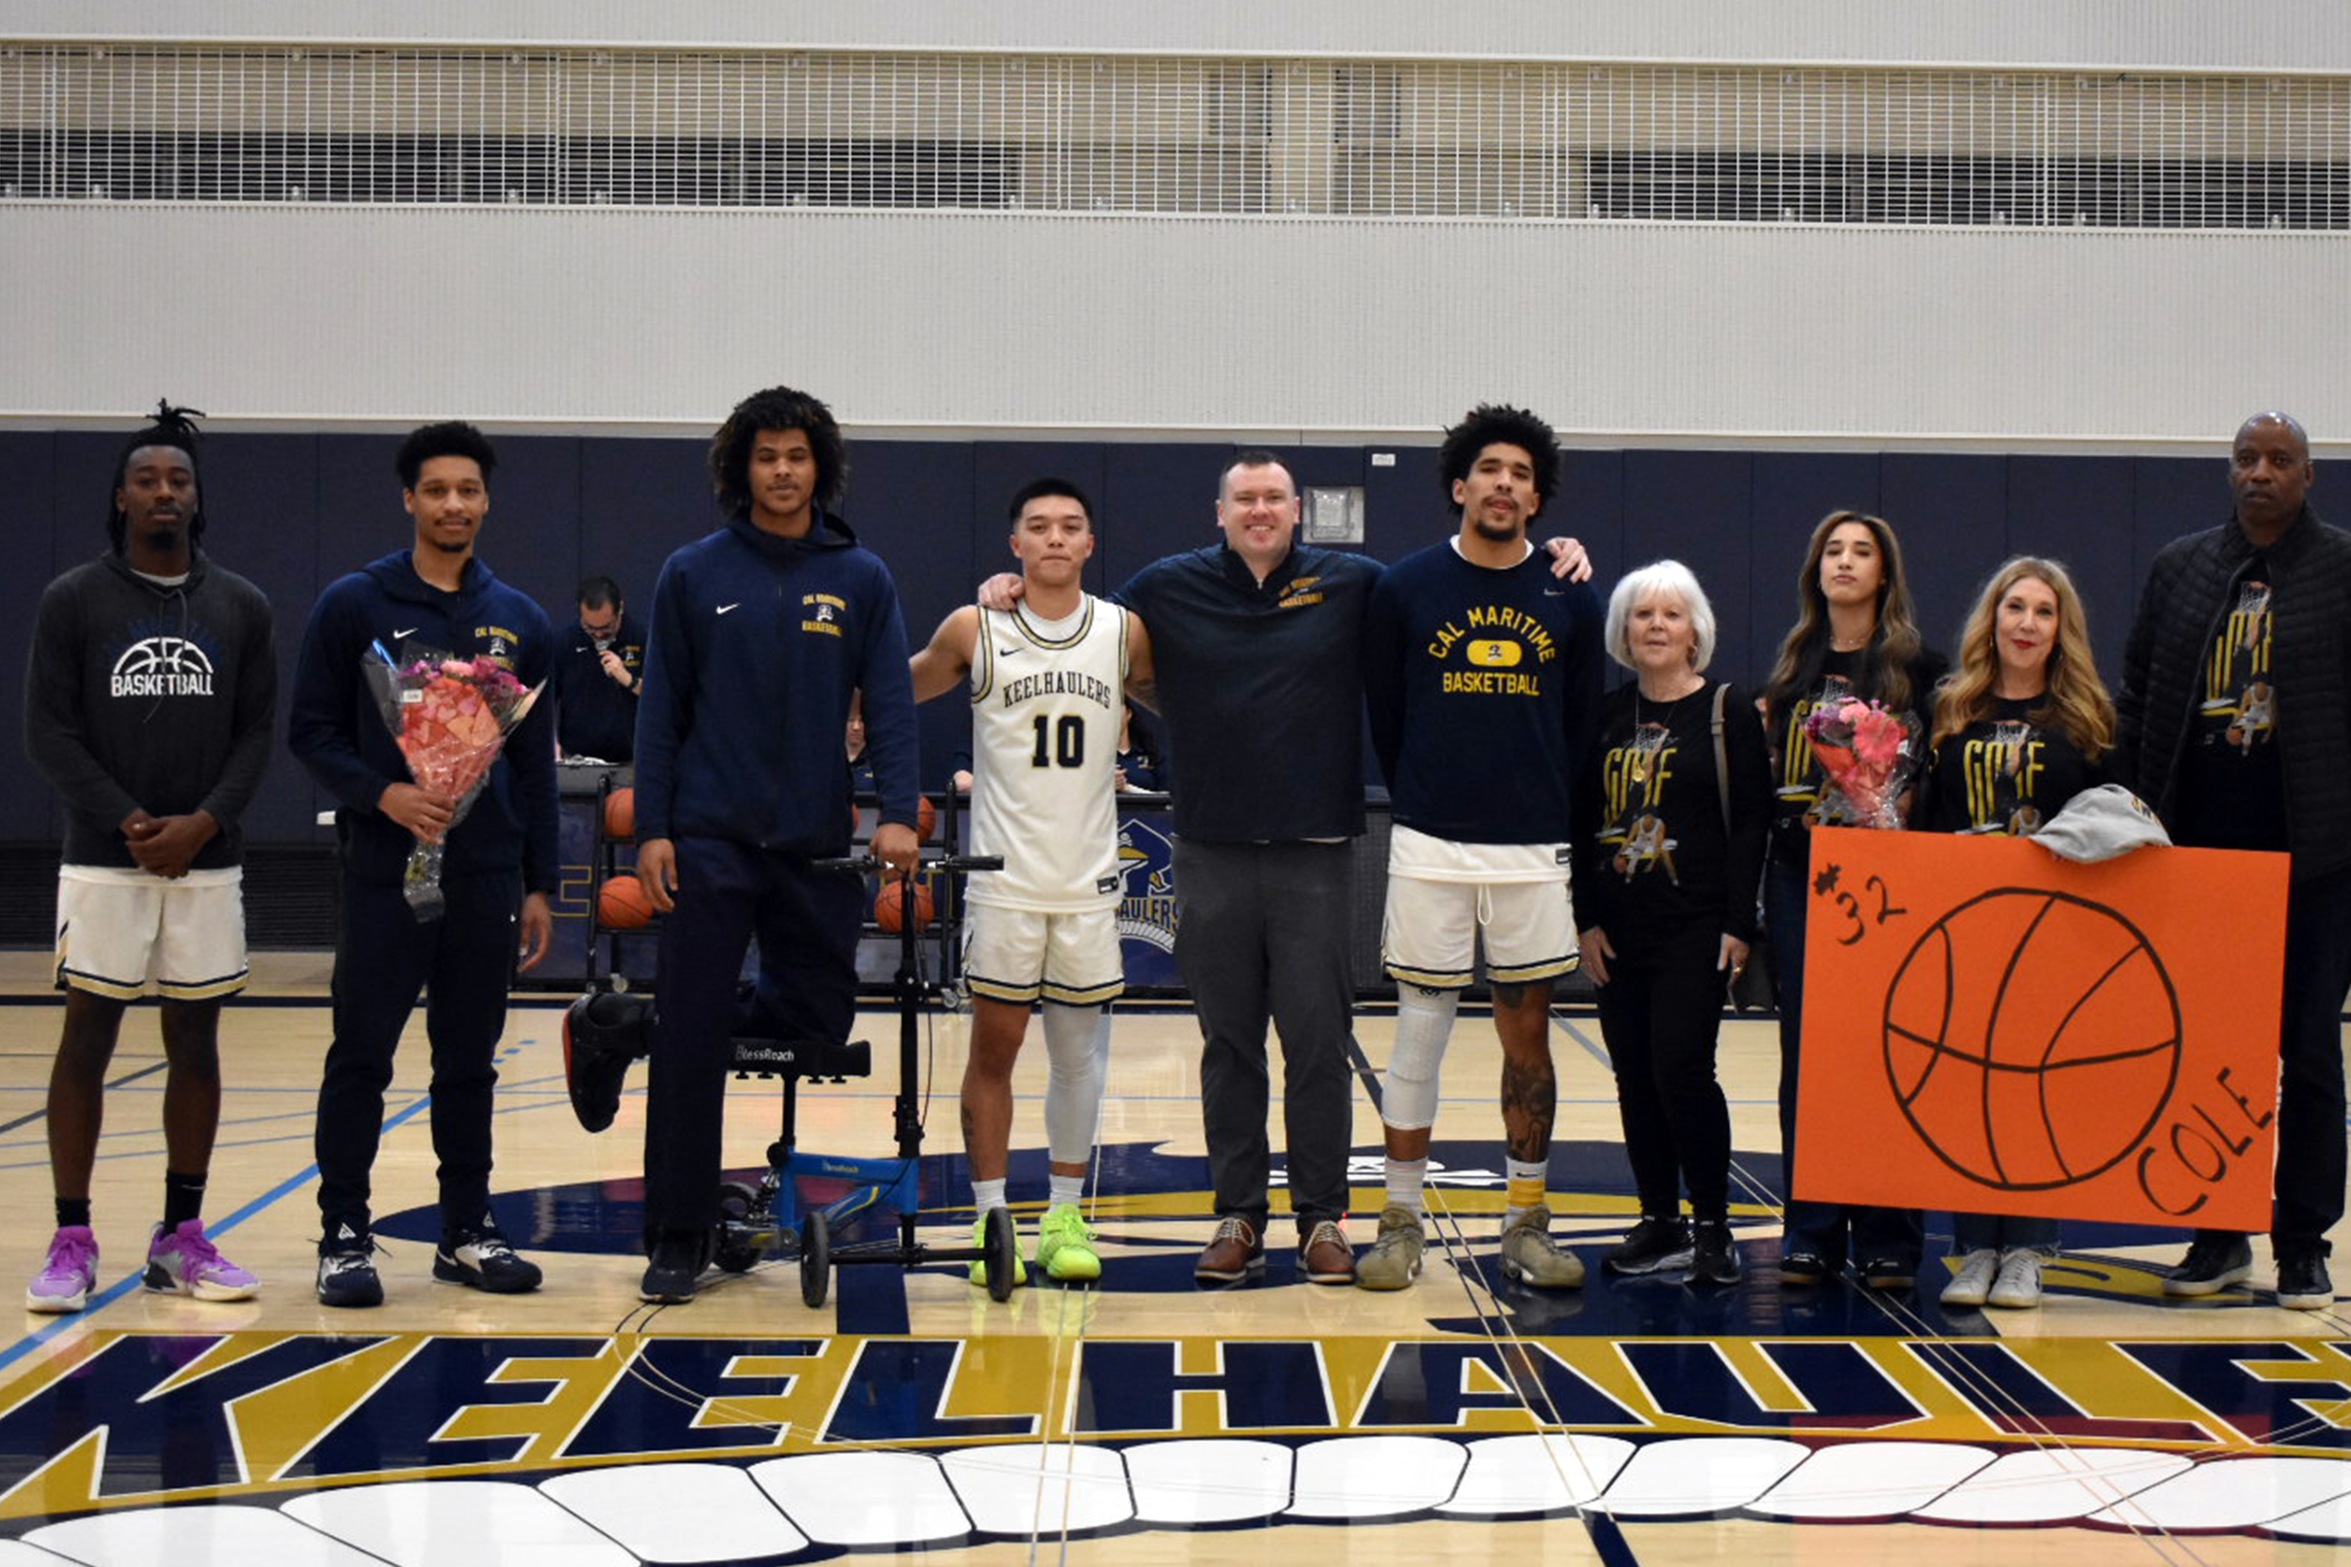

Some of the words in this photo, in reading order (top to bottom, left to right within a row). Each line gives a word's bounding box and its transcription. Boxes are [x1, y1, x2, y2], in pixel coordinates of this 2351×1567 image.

[1428, 621, 1466, 659] CAL
[1467, 605, 1556, 663] MARITIME
[110, 673, 214, 697] BASKETBALL
[1003, 670, 1112, 710] KEELHAULERS
[1443, 671, 1540, 697] BASKETBALL
[1032, 713, 1084, 769] 10
[1812, 862, 1907, 946] #32
[2137, 1066, 2273, 1216] COLE
[0, 1333, 2351, 1500] KEELHAULE
